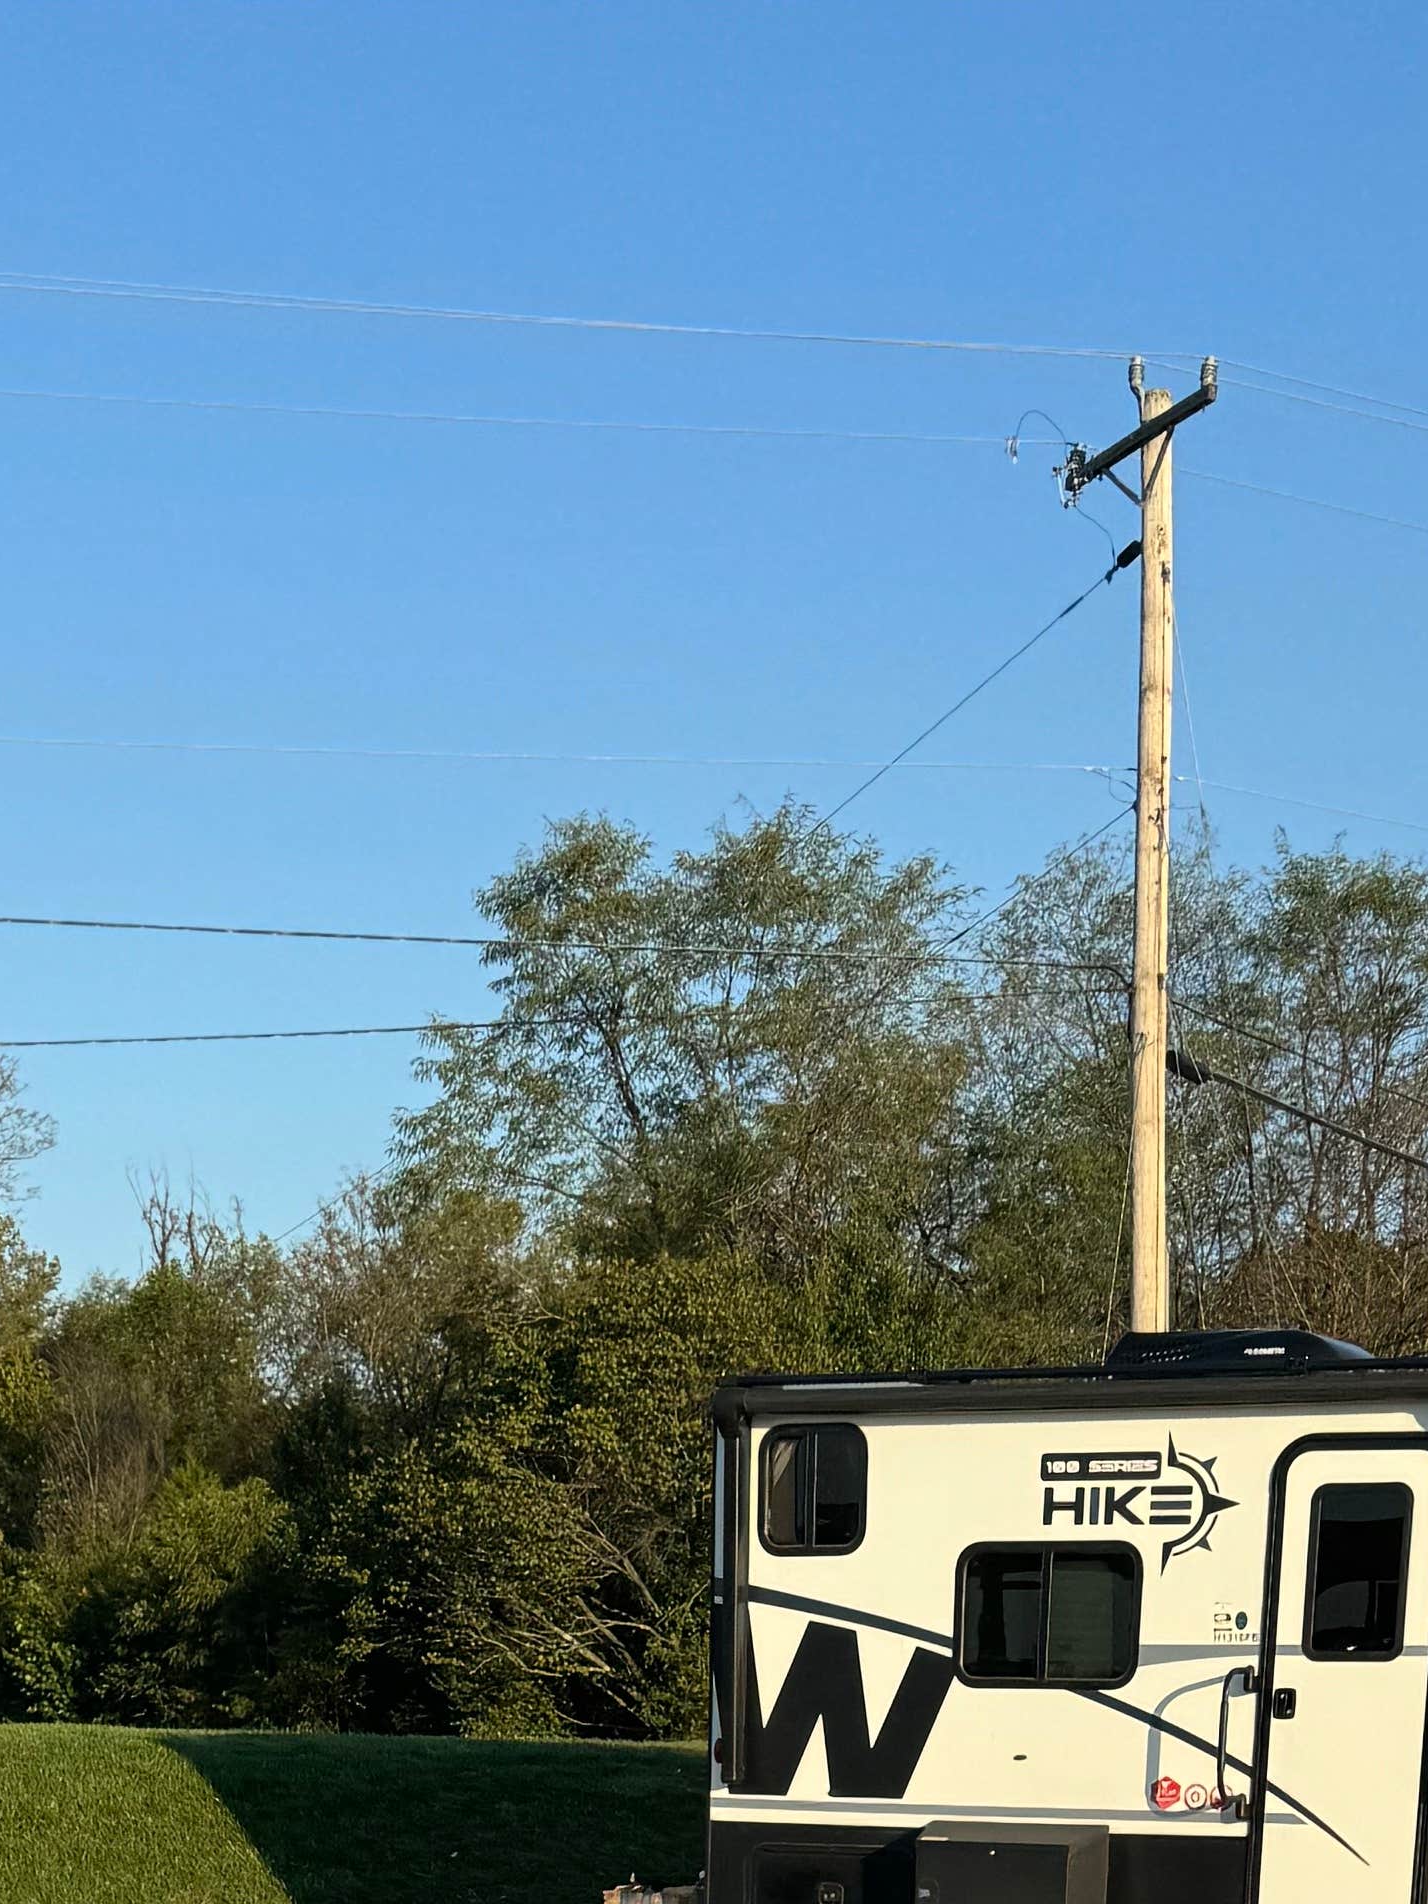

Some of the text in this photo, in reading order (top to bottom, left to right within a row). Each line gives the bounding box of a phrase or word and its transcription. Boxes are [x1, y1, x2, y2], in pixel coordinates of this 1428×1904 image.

[1046, 1459, 1158, 1474] 100 SERIES
[1042, 1486, 1193, 1526] HIKE
